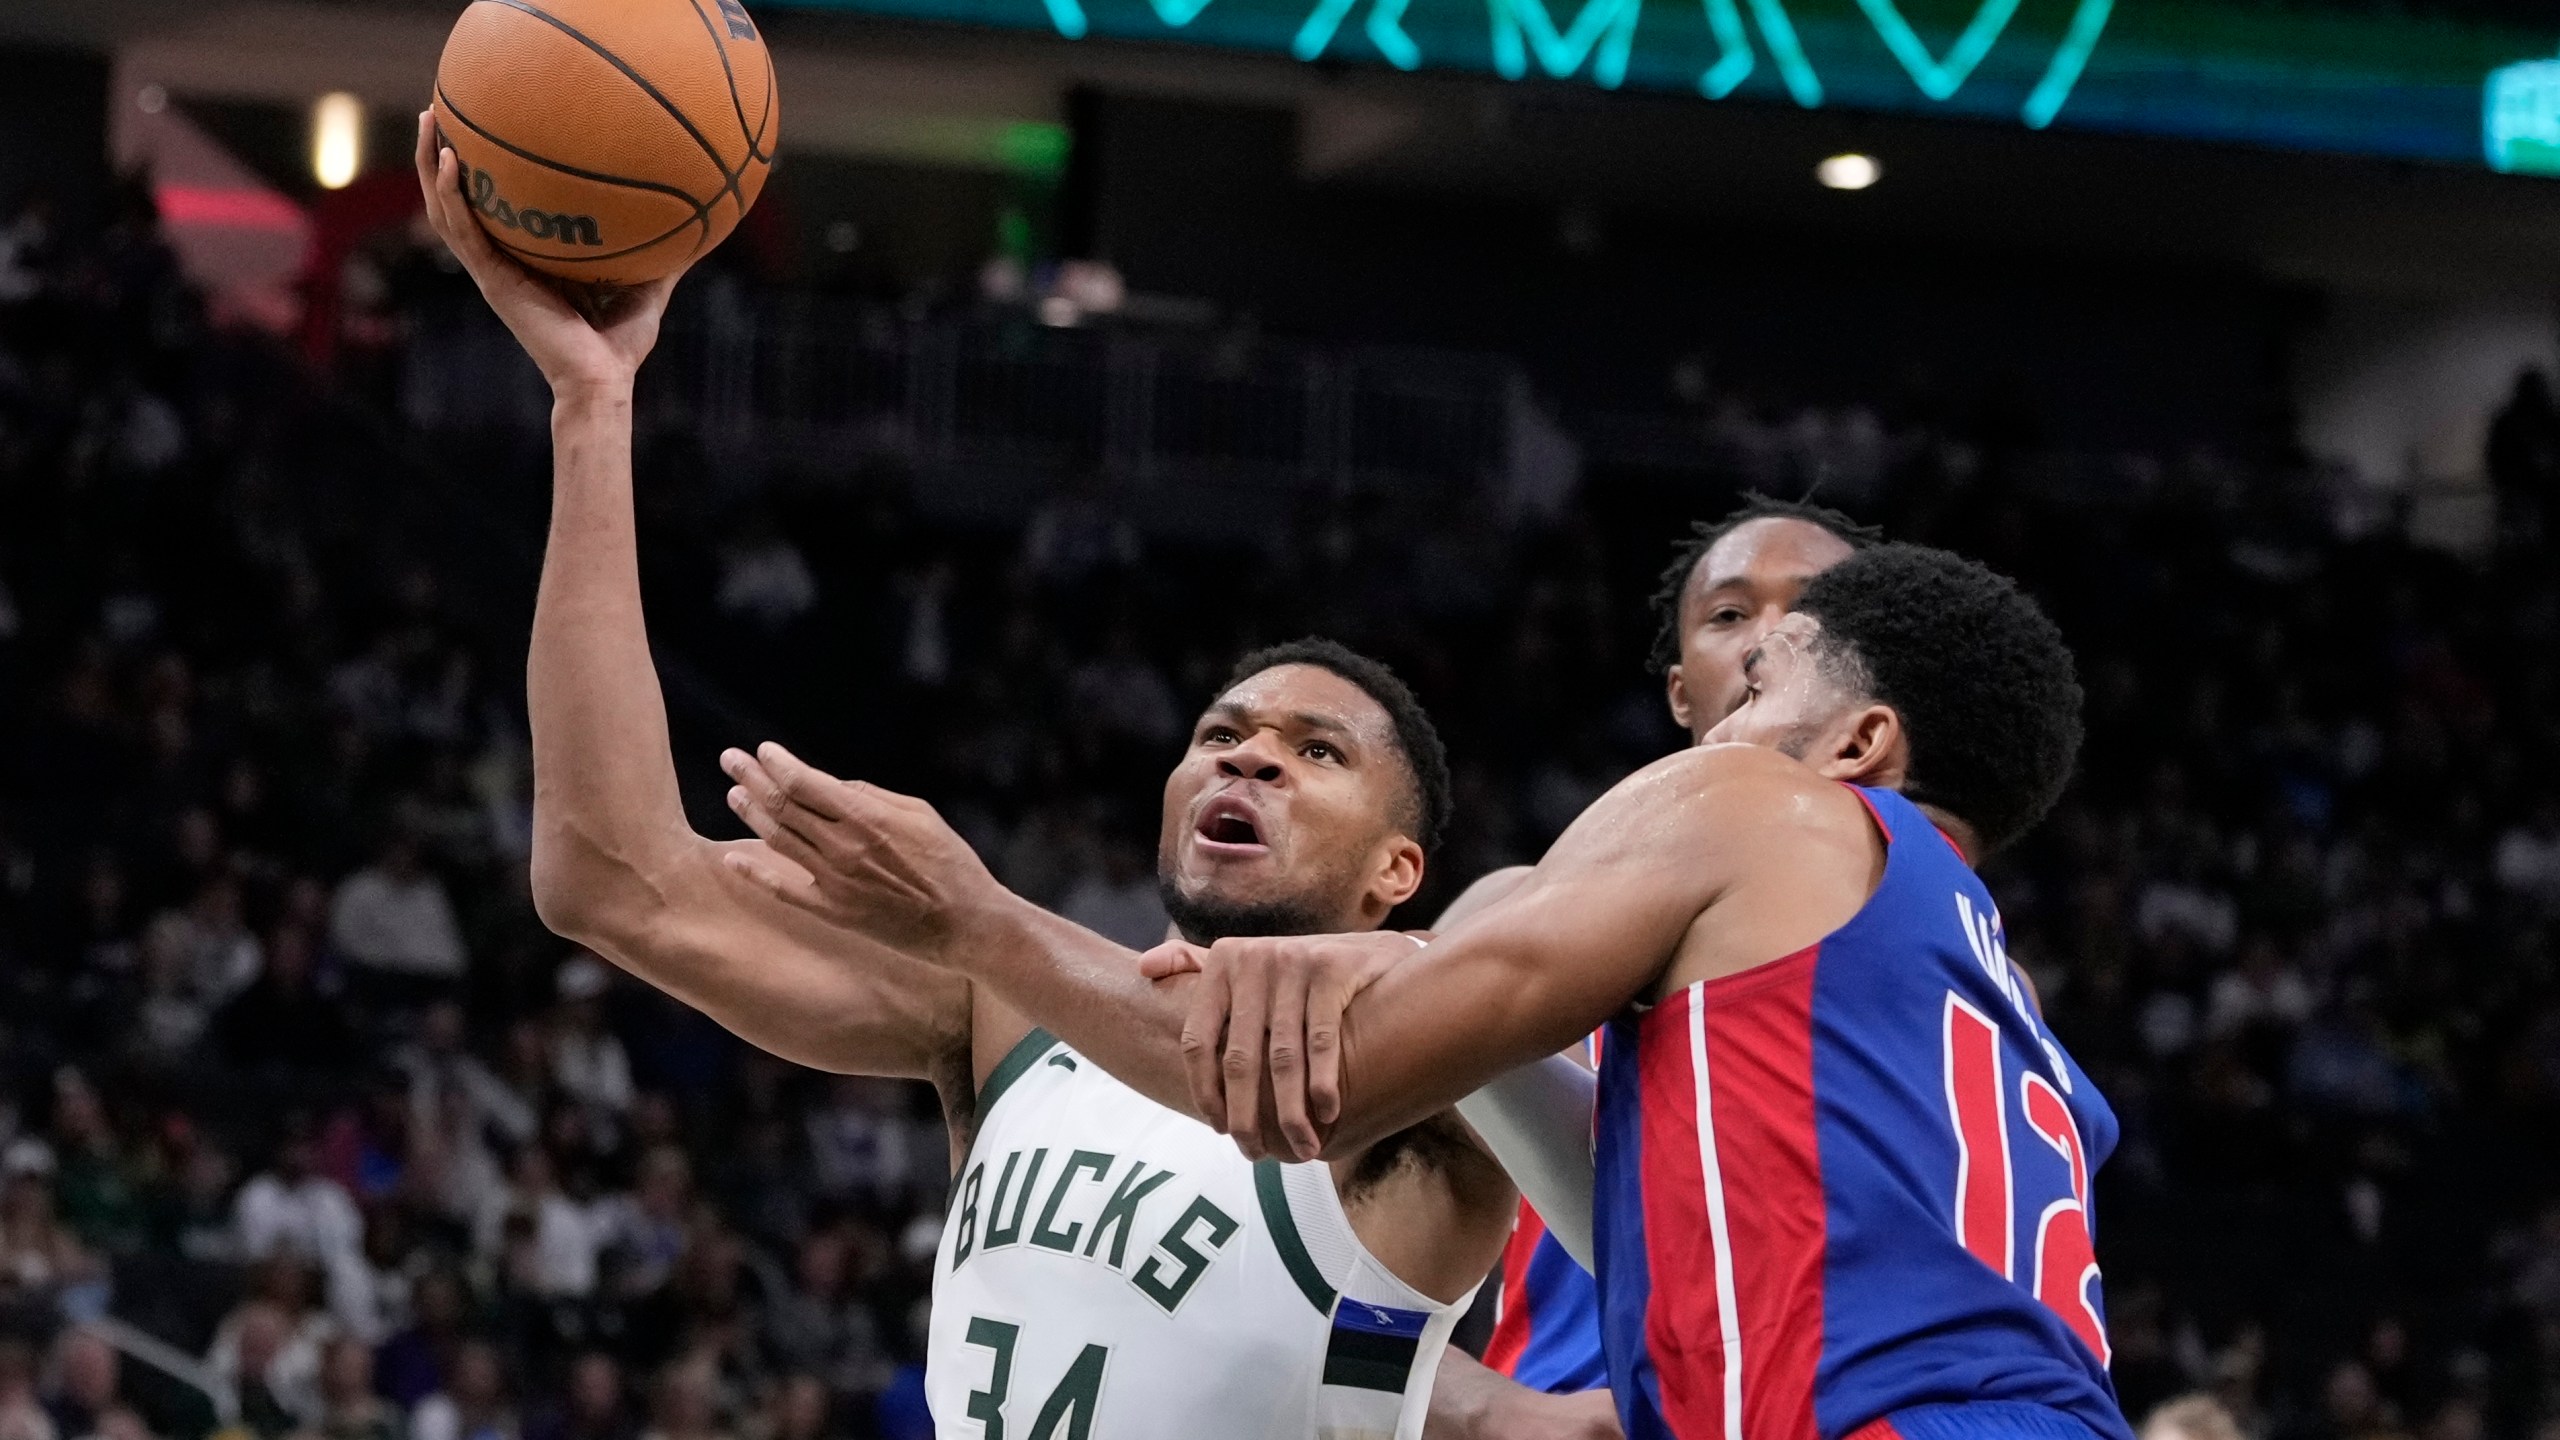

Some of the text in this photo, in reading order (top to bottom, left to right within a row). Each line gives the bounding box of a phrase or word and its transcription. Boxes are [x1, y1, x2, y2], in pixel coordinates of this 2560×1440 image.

[439, 130, 603, 246] lson
[950, 1147, 1242, 1316] BUCKS
[1943, 988, 2112, 1371] 12
[964, 1314, 1112, 1440] 34
